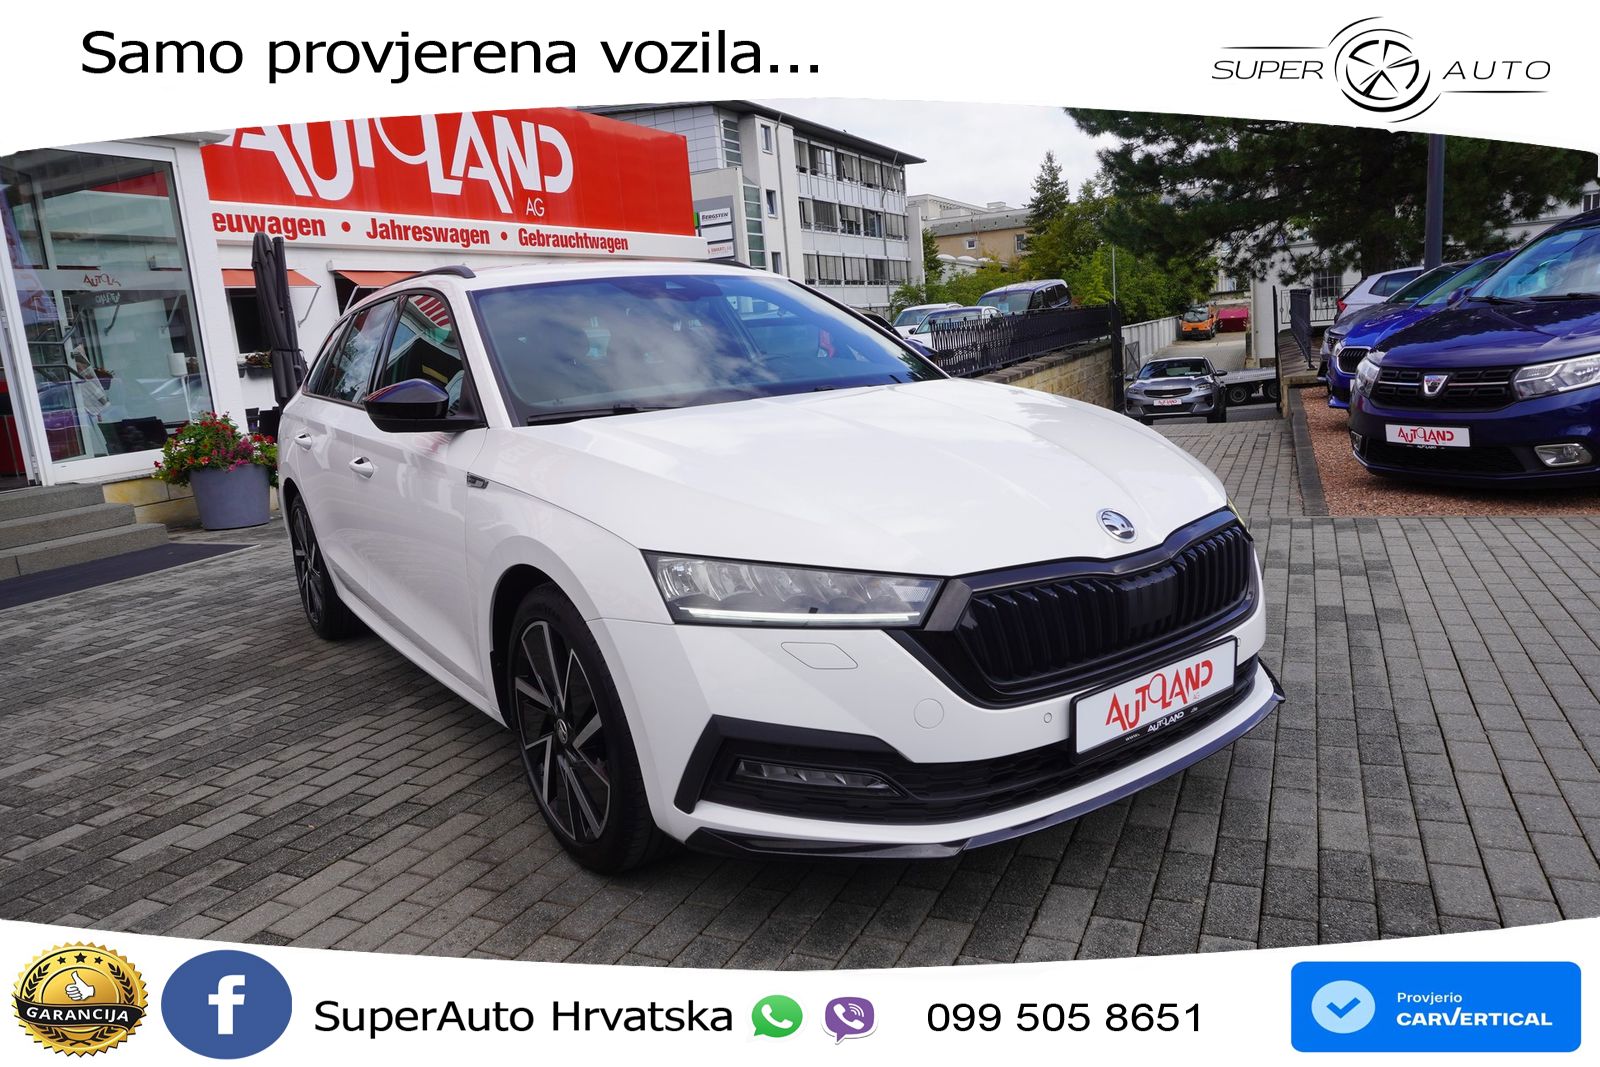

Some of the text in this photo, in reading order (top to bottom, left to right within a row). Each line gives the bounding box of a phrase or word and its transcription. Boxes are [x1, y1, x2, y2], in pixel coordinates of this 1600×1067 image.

[525, 196, 545, 217] AG
[366, 217, 491, 248] Jahreswagen
[517, 228, 629, 253] Gebrauchtwagen
[1398, 426, 1454, 444] AUTOLAND
[1105, 659, 1213, 731] AUTOLAND
